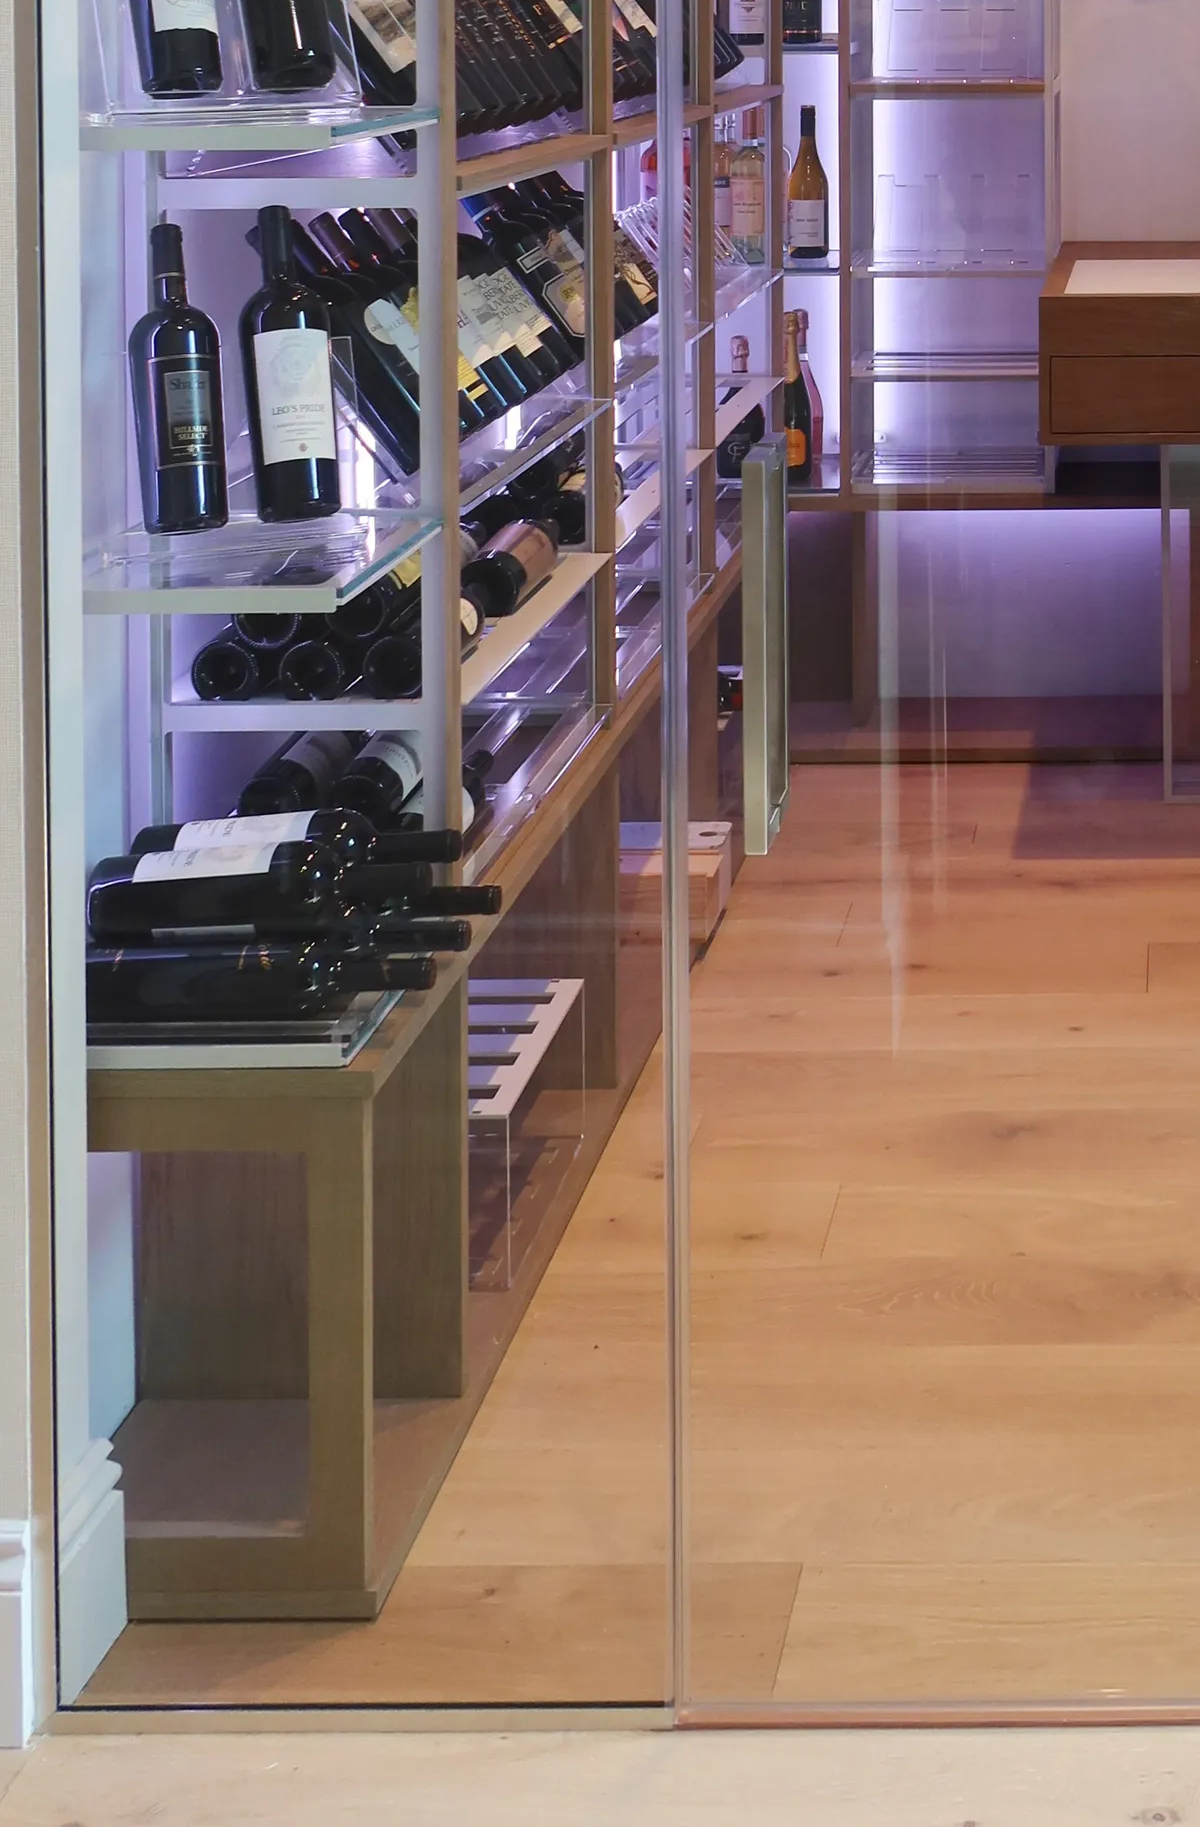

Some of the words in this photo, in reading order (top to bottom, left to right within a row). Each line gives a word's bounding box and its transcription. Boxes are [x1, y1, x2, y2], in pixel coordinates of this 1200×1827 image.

[272, 404, 298, 416] LEO'S
[299, 404, 326, 413] PRIDE
[173, 424, 209, 434] HILLSIDE
[178, 432, 206, 441] SELECT
